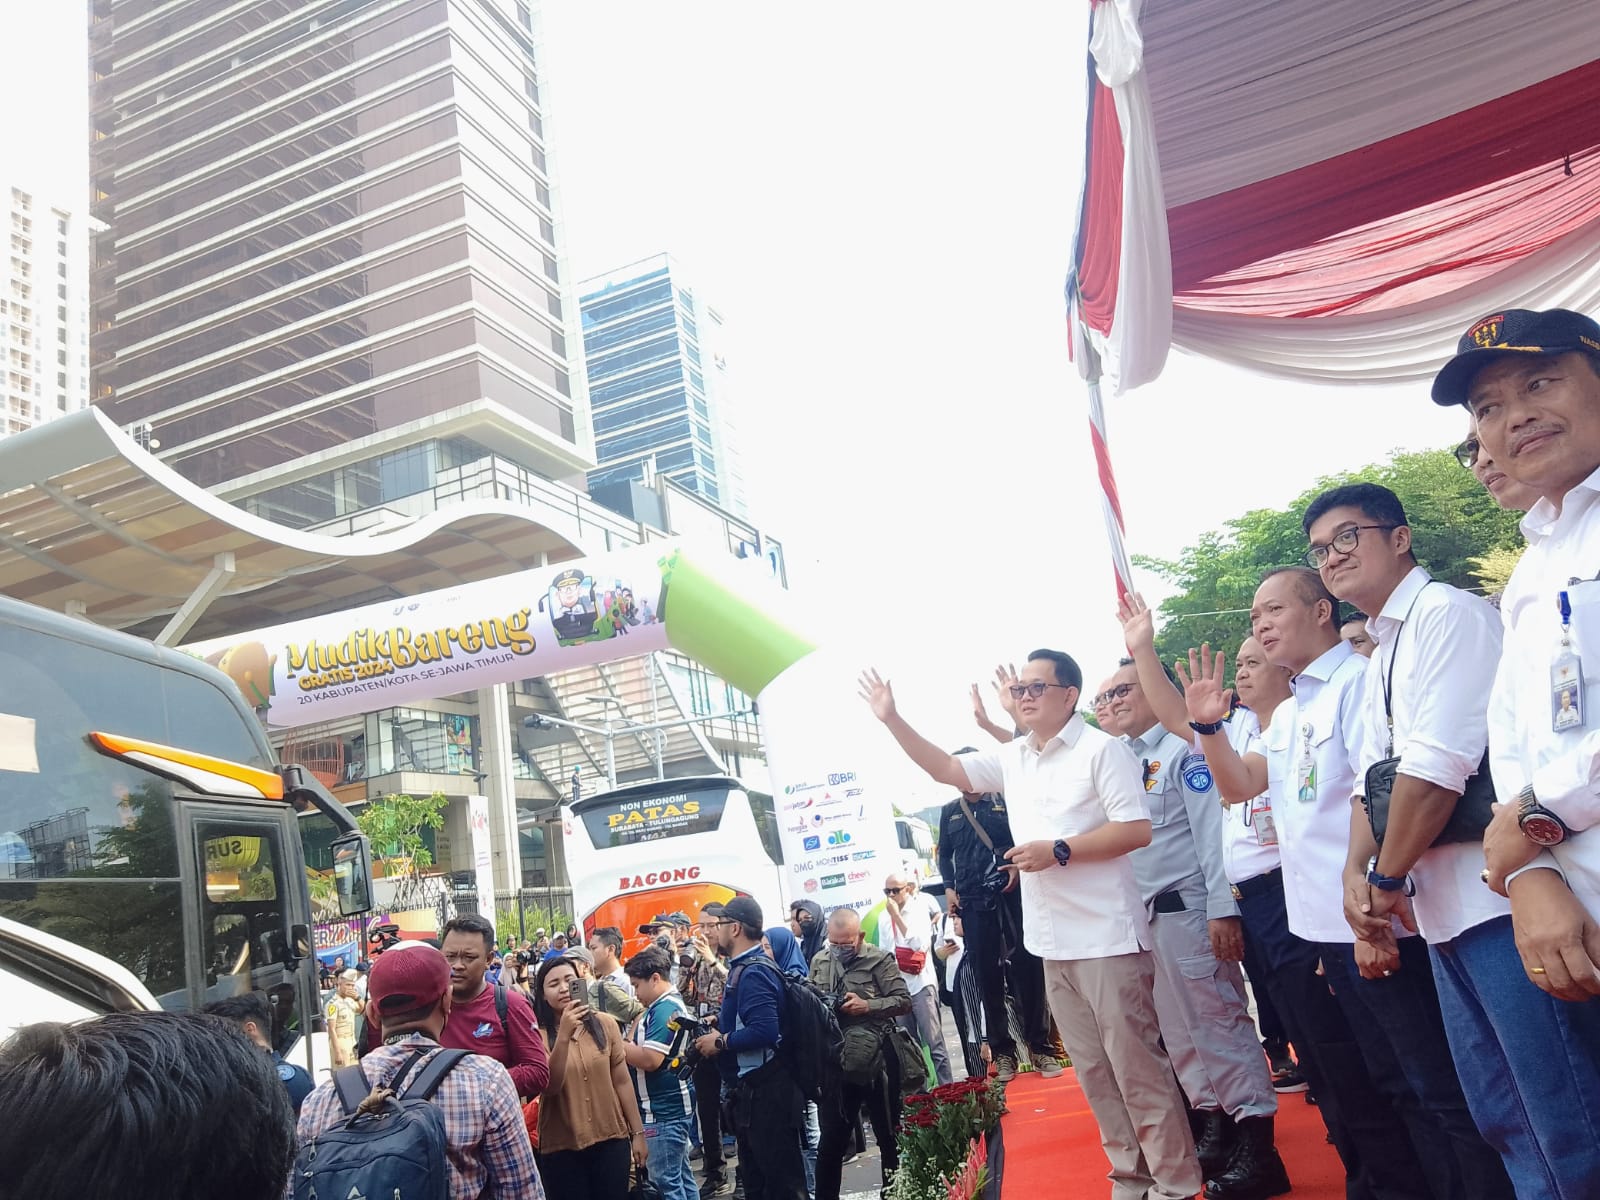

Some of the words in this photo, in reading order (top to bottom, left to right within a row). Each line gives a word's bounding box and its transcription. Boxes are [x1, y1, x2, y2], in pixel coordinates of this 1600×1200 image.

[297, 695, 313, 706] 20
[313, 673, 419, 702] KABUPATEN/KOTA
[420, 662, 475, 680] SE-JAWA
[477, 653, 516, 669] TIMUR
[298, 668, 354, 691] GRATIS
[354, 660, 394, 681] 2024
[840, 771, 856, 783] BRI
[608, 801, 700, 827] PATAS
[620, 802, 641, 812] NON
[642, 794, 687, 808] EKONOMI
[649, 814, 699, 826] TULUNGAGUNG
[619, 866, 700, 889] BAGONG
